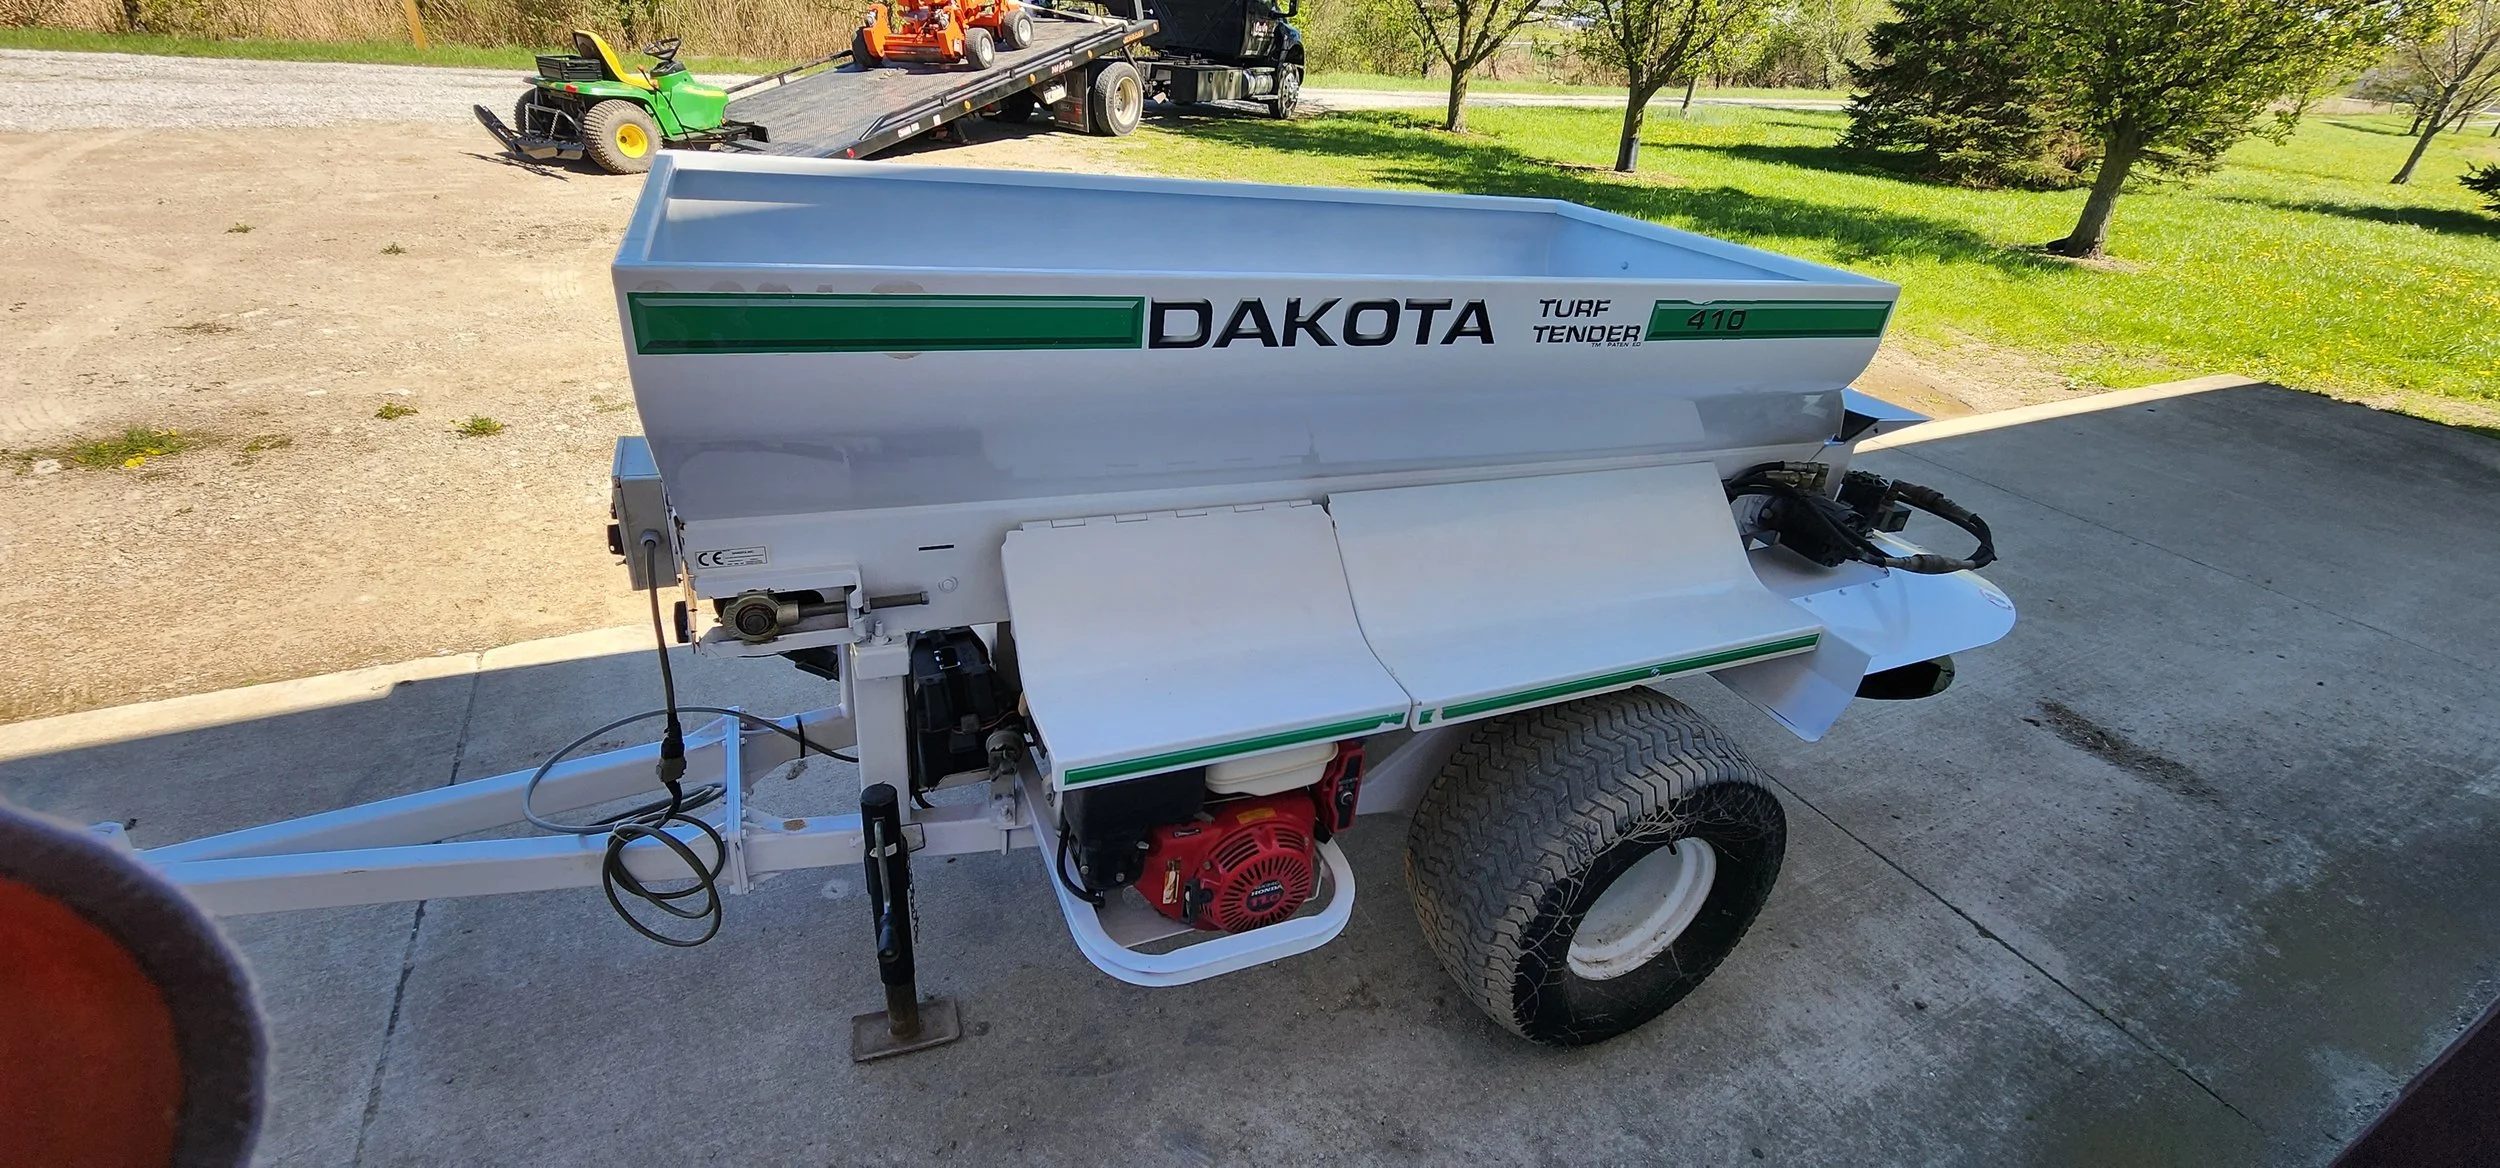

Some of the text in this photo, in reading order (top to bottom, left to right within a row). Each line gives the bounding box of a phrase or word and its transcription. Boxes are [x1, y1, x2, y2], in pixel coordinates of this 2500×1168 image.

[1539, 298, 1611, 318] TURF
[1148, 296, 1495, 349] DAKOTA
[1686, 307, 1747, 331] 410
[1532, 324, 1641, 343] TENDER
[1251, 884, 1284, 897] HONDA
